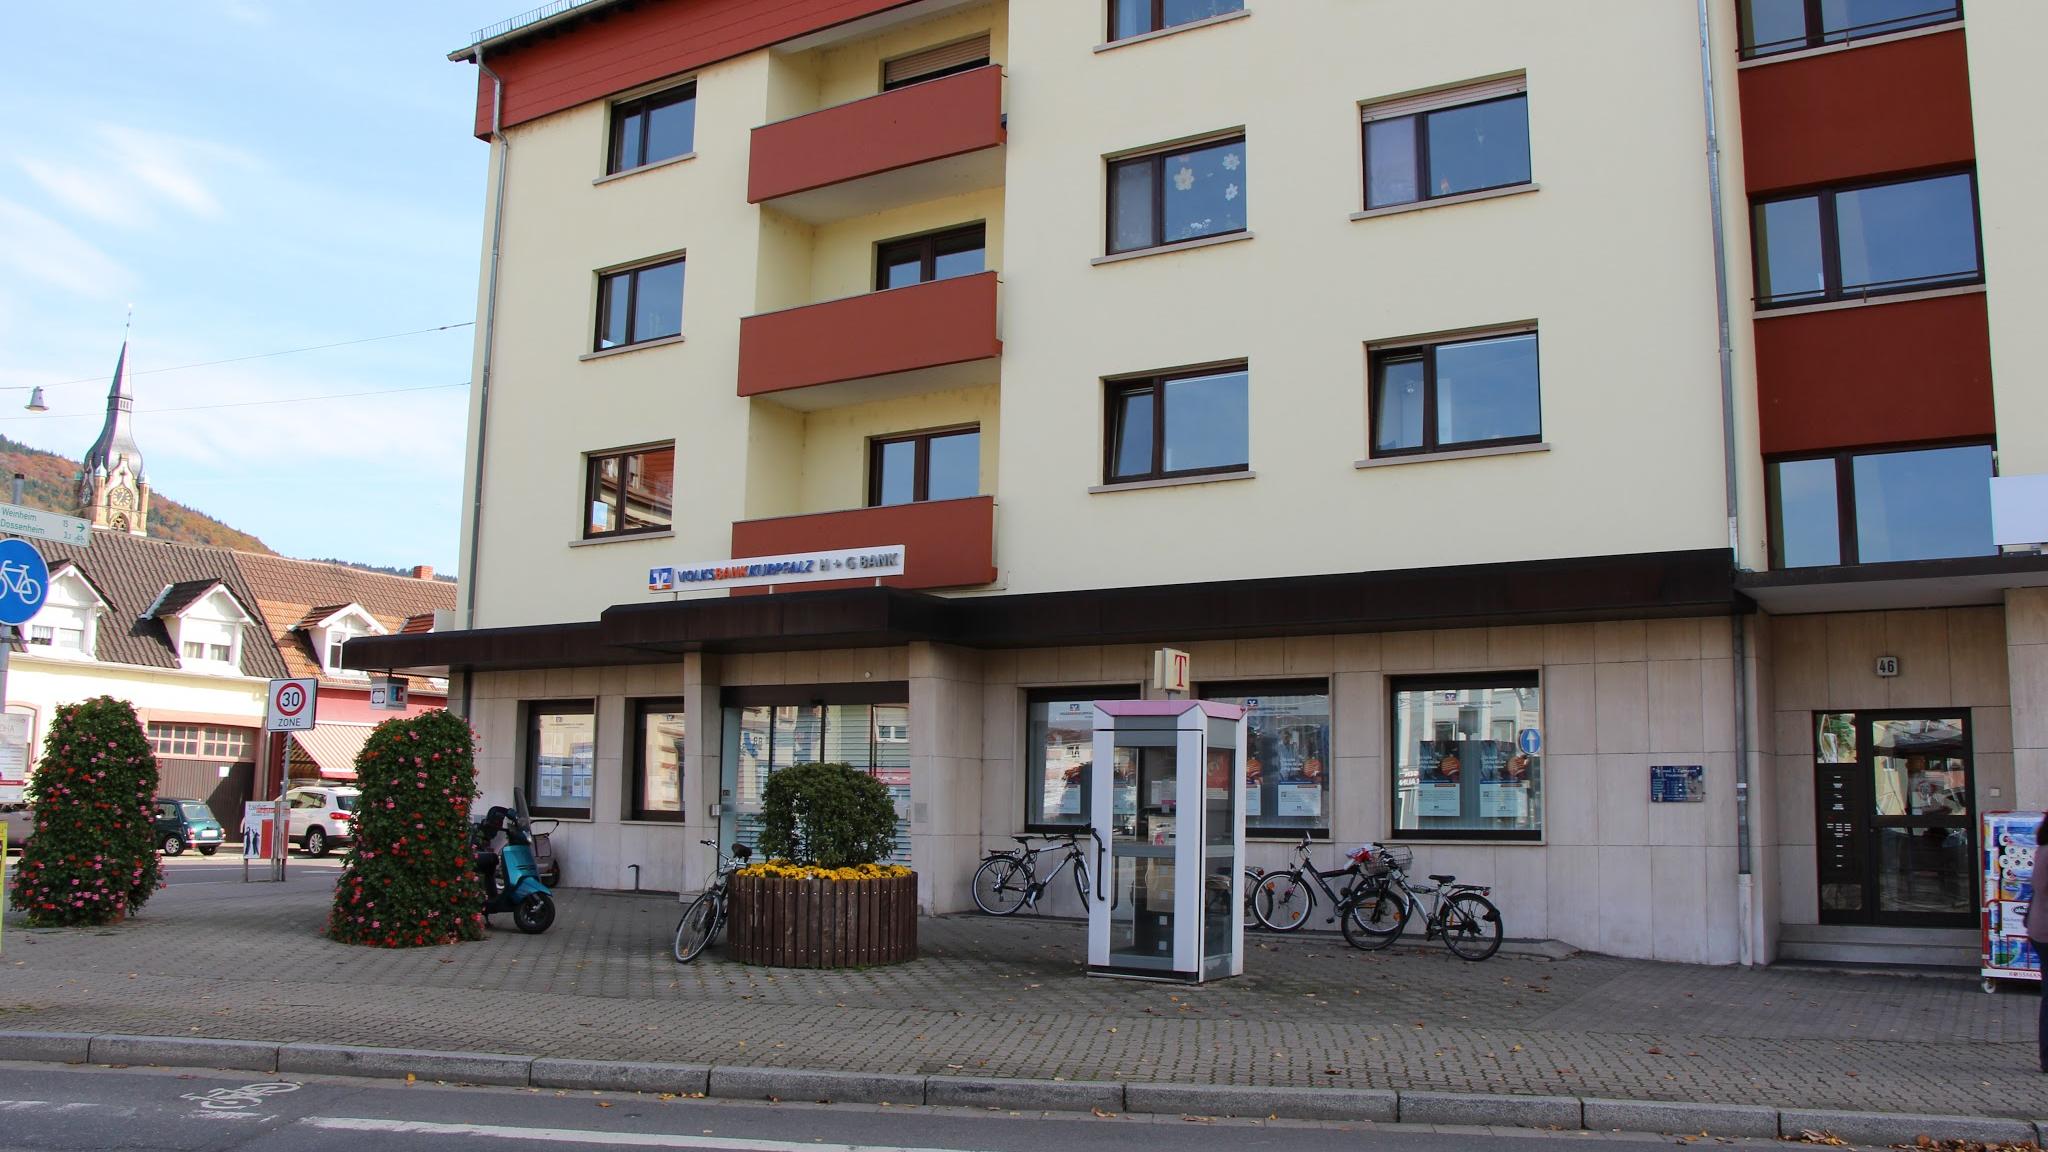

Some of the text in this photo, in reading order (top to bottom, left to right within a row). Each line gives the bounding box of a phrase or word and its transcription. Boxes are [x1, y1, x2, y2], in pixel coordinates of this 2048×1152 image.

[2, 507, 37, 521] Weinheim
[0, 518, 45, 534] Dossenheim
[820, 559, 830, 571] H
[846, 556, 857, 570] G
[860, 552, 898, 569] BANK
[1174, 654, 1187, 687] T
[1879, 659, 1895, 673] 46
[282, 691, 300, 707] 30
[278, 718, 301, 727] ZONE
